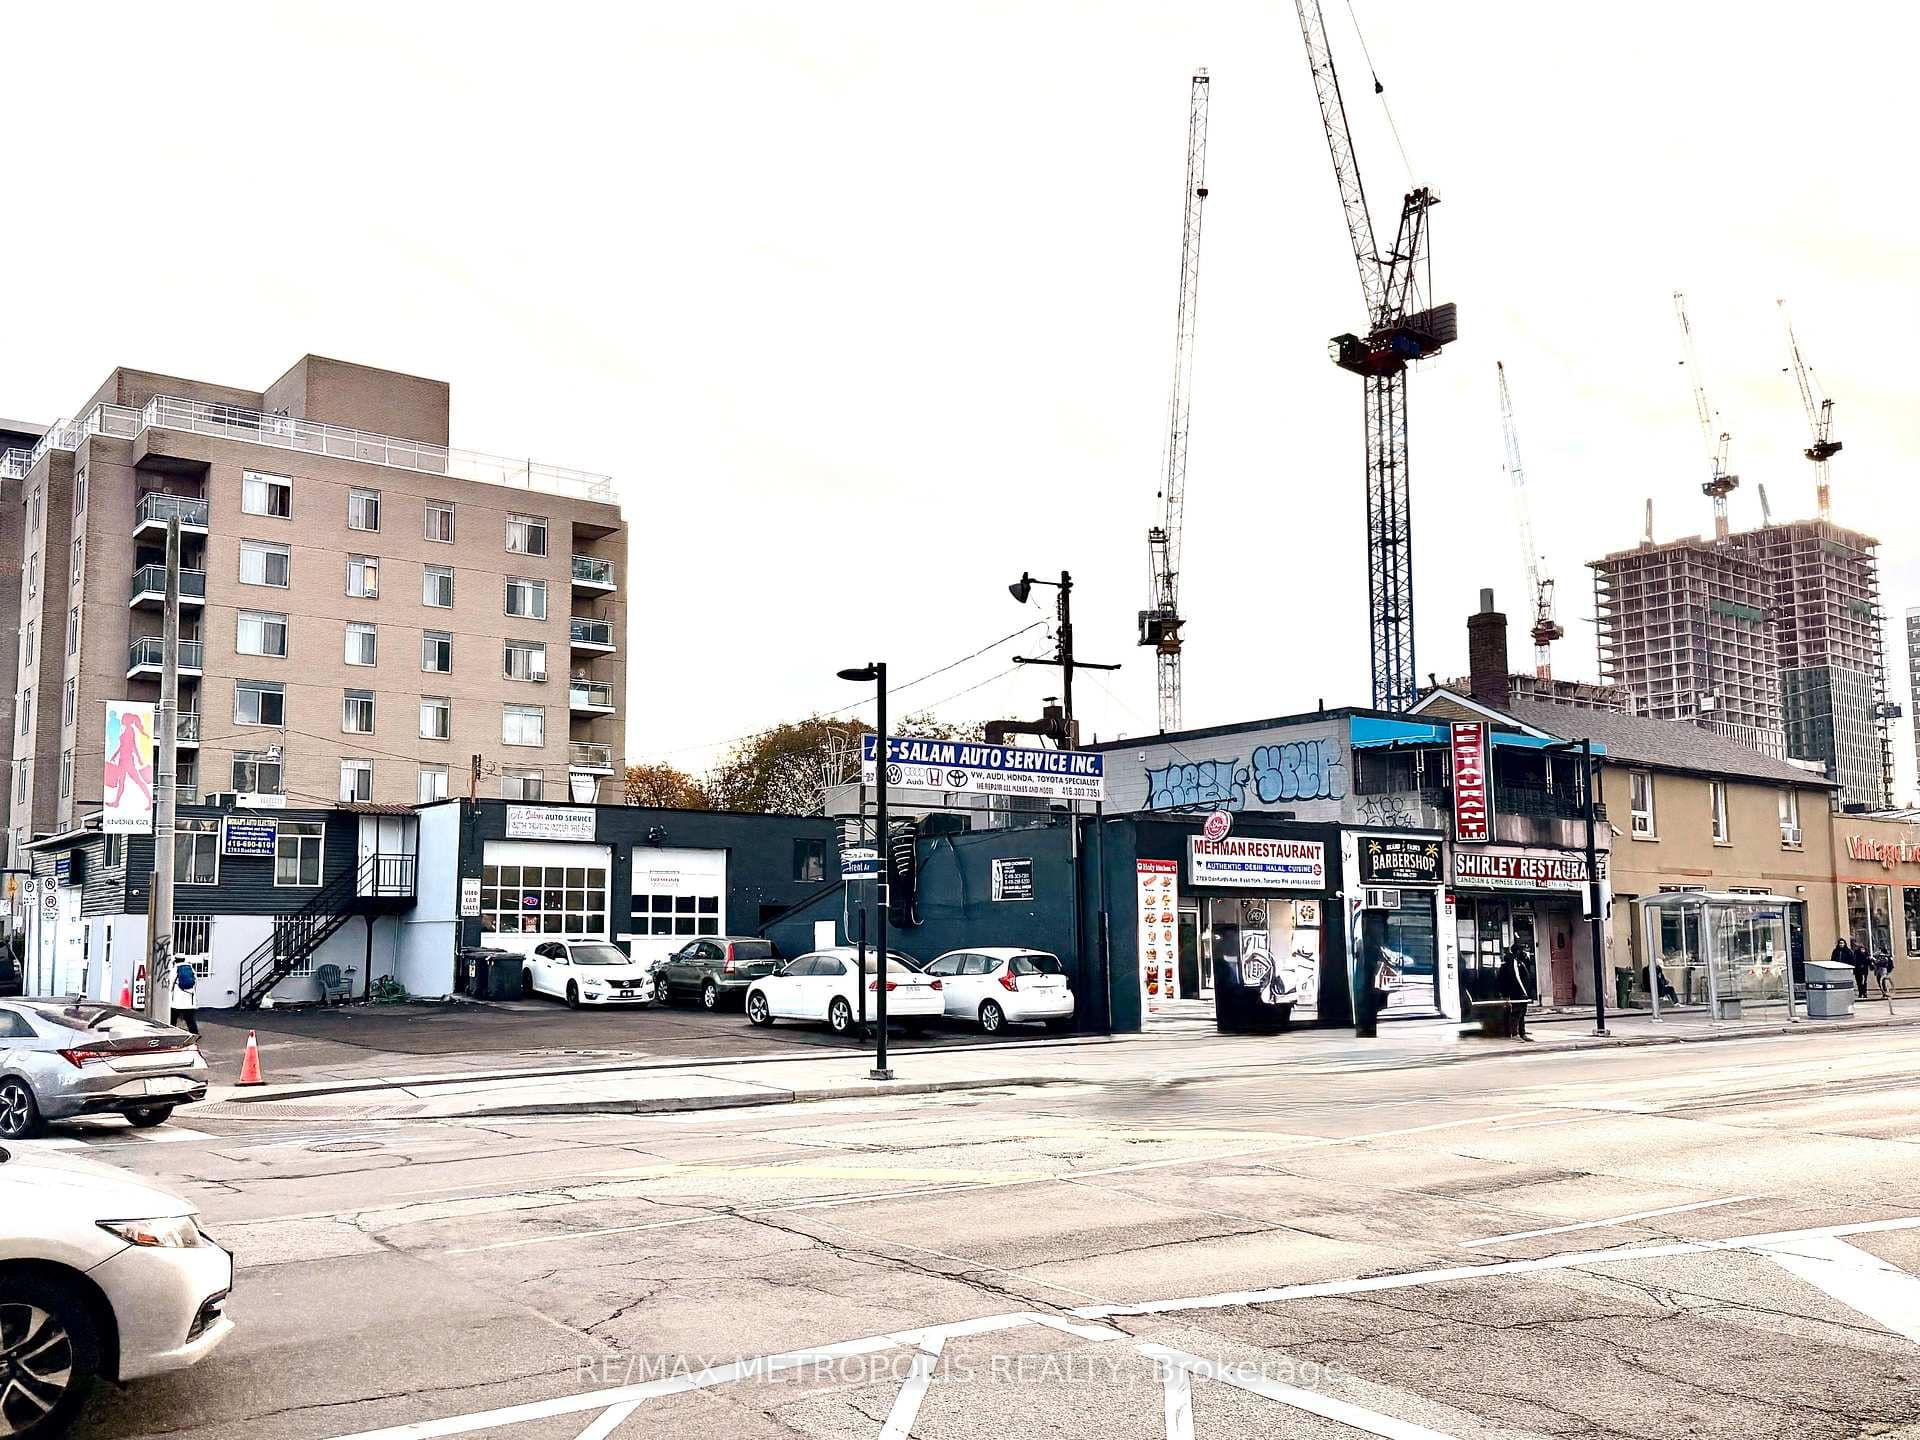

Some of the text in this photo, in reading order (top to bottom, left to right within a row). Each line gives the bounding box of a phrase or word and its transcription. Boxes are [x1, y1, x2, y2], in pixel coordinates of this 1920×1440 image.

[958, 746, 1002, 768] AUTO
[1004, 750, 1067, 772] SERVICE
[1070, 755, 1100, 775] INC.
[1007, 774, 1034, 783] HONDA,
[1037, 776, 1063, 784] TOYOTA
[1065, 778, 1100, 787] SPECIALIST
[1455, 724, 1485, 831] RESTAURANT
[545, 814, 564, 822] AUTO
[565, 815, 592, 823] SERVICE
[1247, 842, 1321, 860] RESTAURANT
[1206, 862, 1242, 871] AUTHENTIC
[1266, 864, 1286, 872] HALAL
[1287, 865, 1312, 873] CUISINE
[1372, 853, 1436, 872] BARBERSHOP
[1456, 854, 1517, 877] SHIRLEY
[1456, 876, 1485, 884] CANADIAN
[1490, 878, 1514, 886] CHINESE
[1514, 879, 1535, 887] CUISINE
